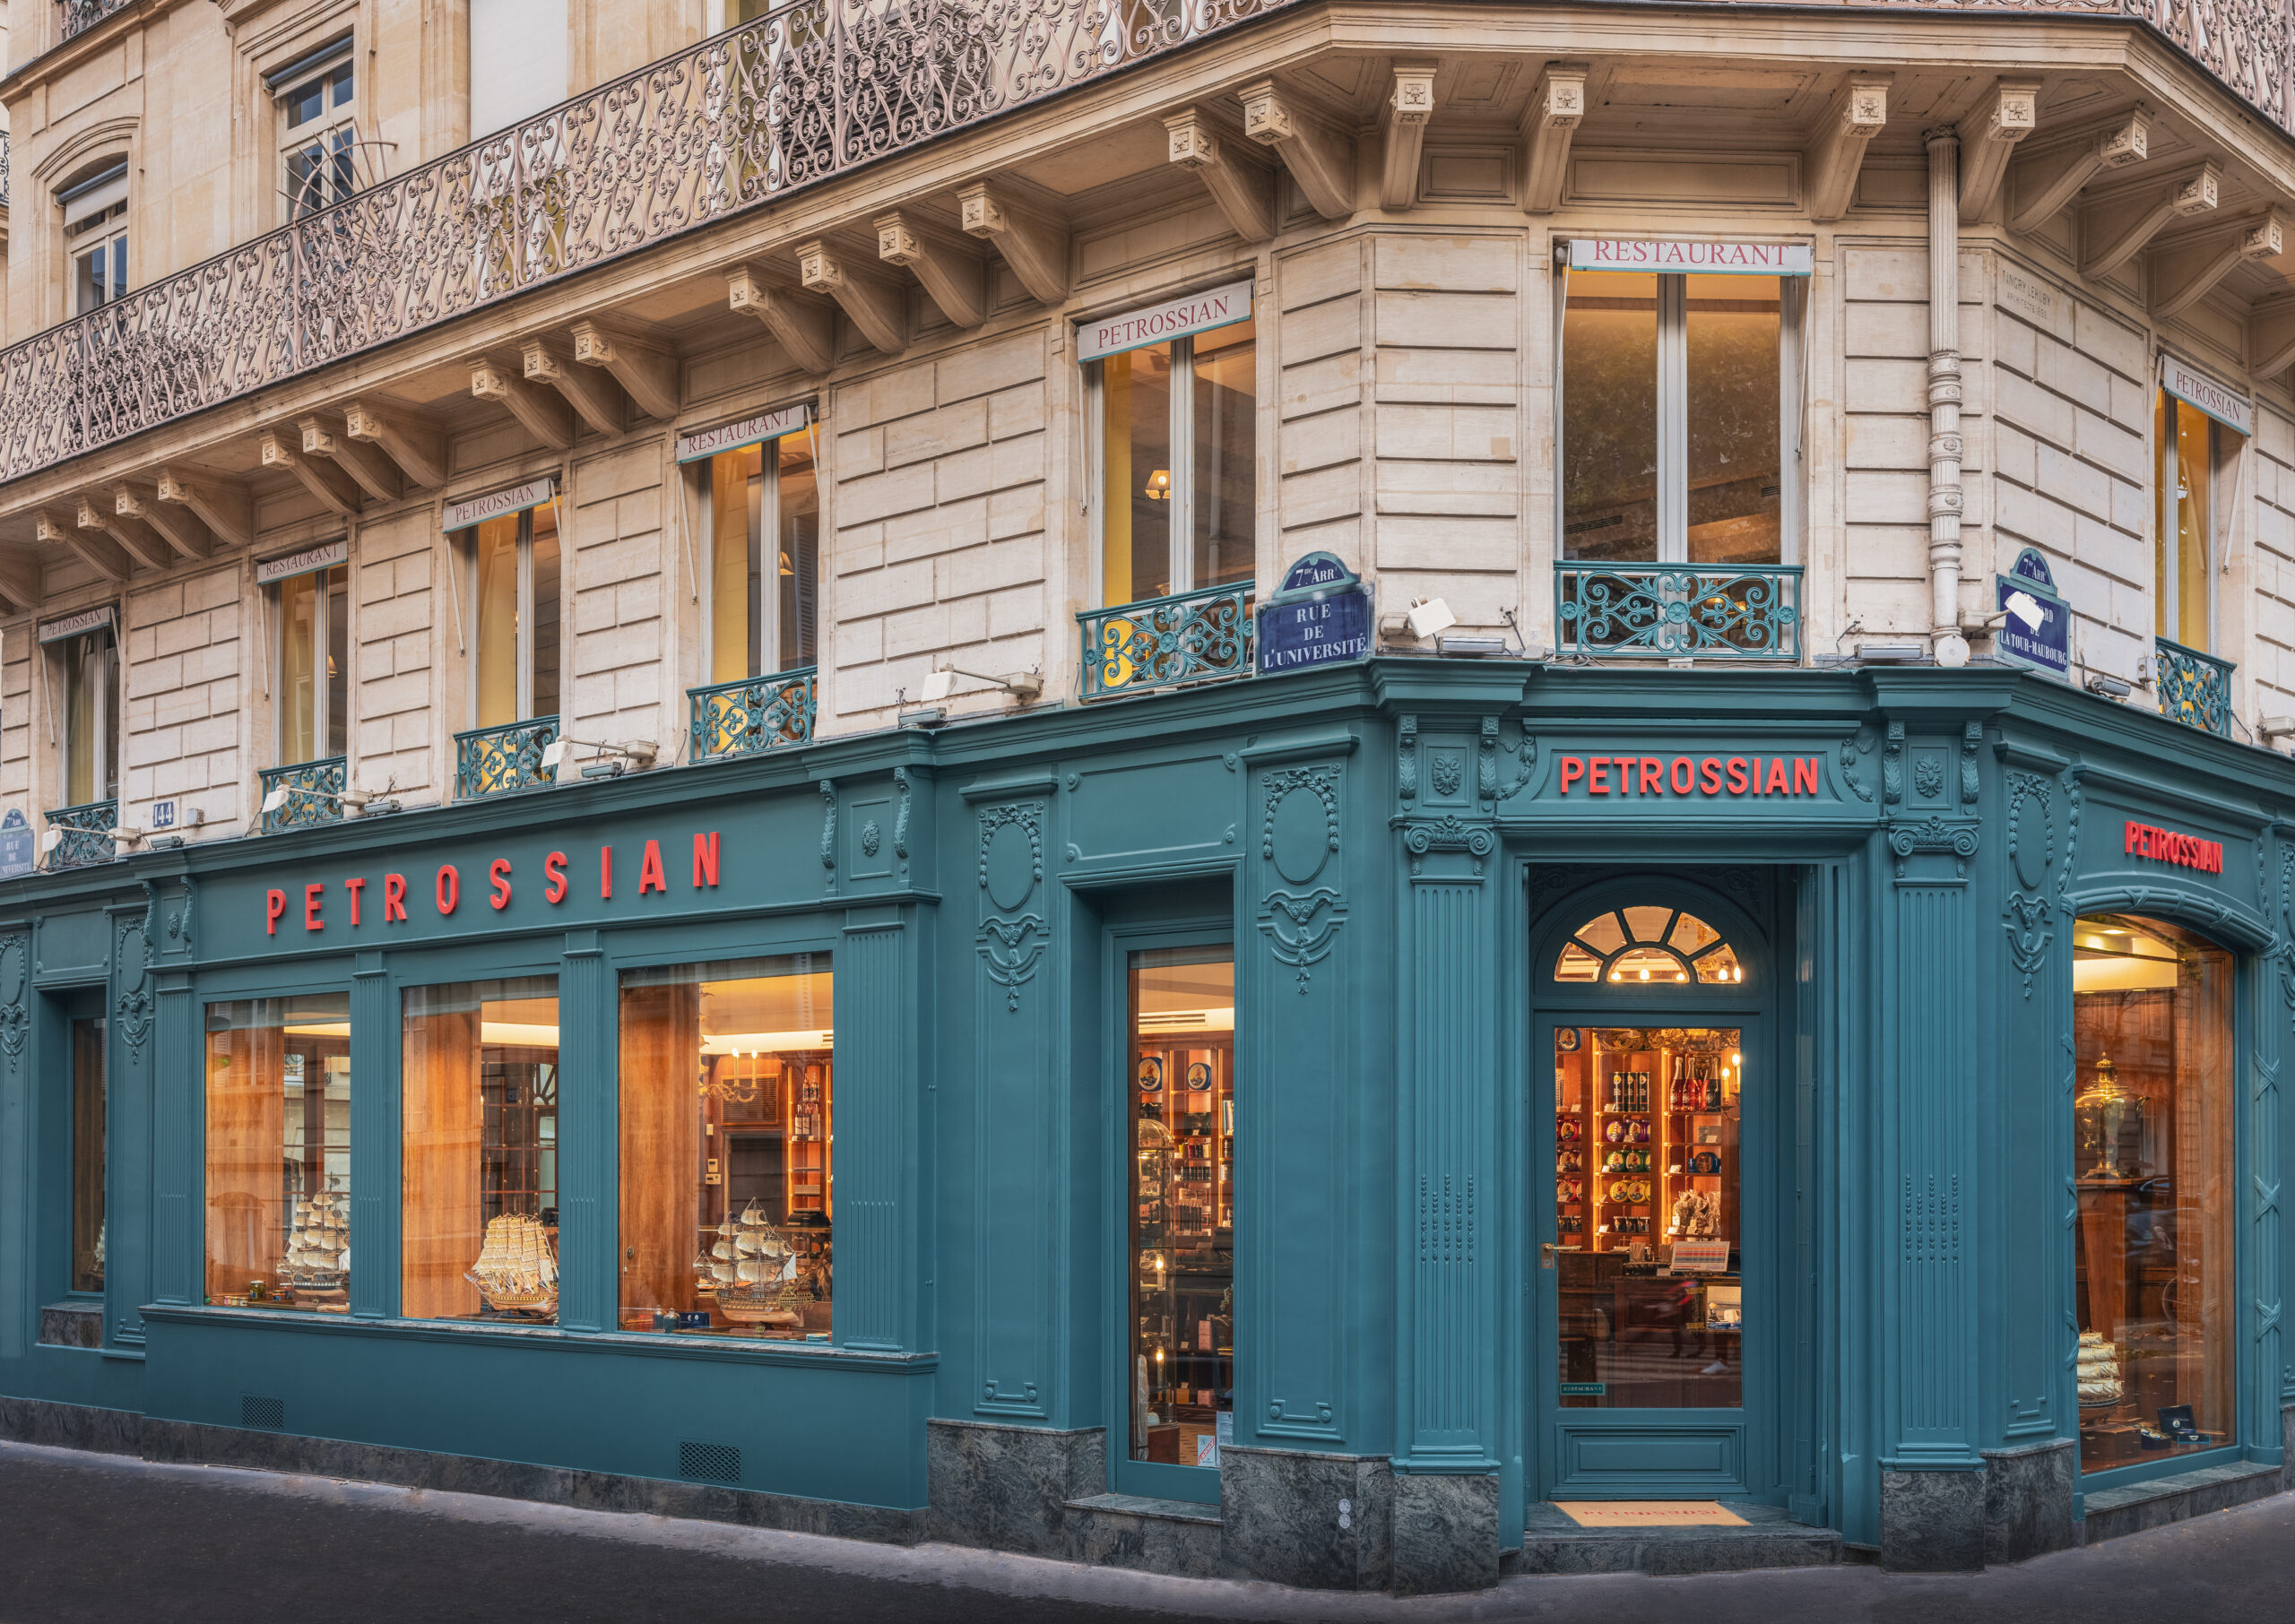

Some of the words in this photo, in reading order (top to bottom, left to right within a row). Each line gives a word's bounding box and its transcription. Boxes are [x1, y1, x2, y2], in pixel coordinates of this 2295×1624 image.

[1592, 239, 1790, 266] RESTAURANT
[1097, 295, 1230, 350] PETROSSIAN
[2176, 370, 2240, 421] PETROSSIAN
[688, 408, 792, 454] RESTAURANT
[455, 484, 535, 522] PETROSSIAN
[266, 543, 339, 576] RESTAURANT
[47, 609, 101, 637] PETROSSIAN
[1295, 603, 1331, 624] RUE
[1263, 633, 1366, 669] L'UNIVERSITÉ
[1303, 625, 1324, 642] DE
[2000, 629, 2010, 645] LA
[2011, 633, 2067, 666] TOUR-MAUBOURG
[1561, 756, 1818, 795] PETROSSIAN
[154, 803, 173, 825] 144
[2125, 820, 2223, 874] PETROSSIAN
[266, 831, 721, 935] PETROSSIAN
